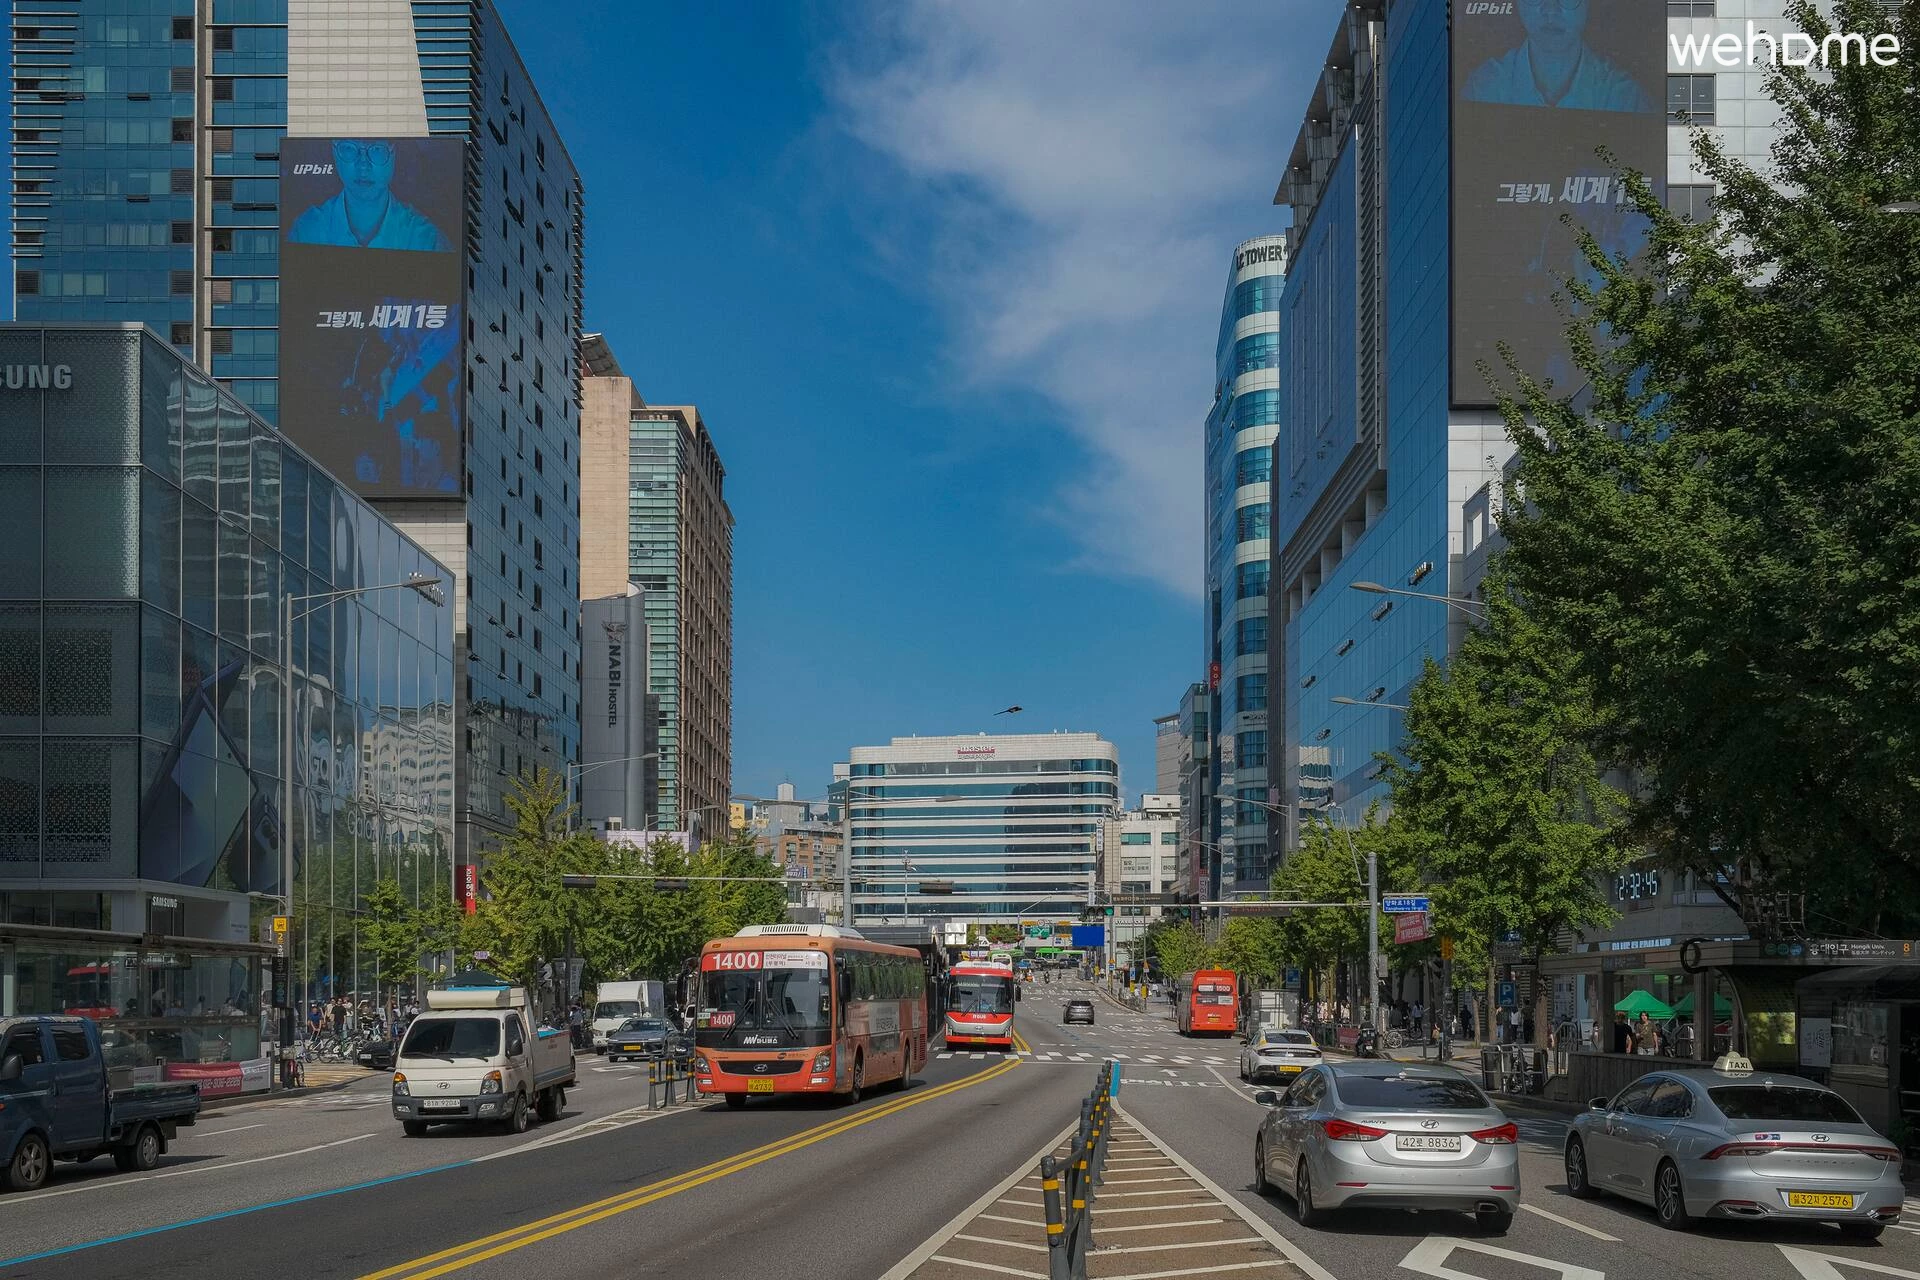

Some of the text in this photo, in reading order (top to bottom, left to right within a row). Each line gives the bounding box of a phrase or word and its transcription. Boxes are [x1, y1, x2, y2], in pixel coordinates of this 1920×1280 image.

[1465, 2, 1513, 15] UPbit
[293, 164, 334, 175] UPbit
[1496, 183, 1553, 204] 그렇게,
[1245, 245, 1283, 267] TOWER
[316, 305, 447, 329] 그렇게, 세계 1등
[0, 364, 73, 389] UNG
[609, 645, 621, 728] NABI HOSTEL
[152, 896, 178, 908] SAMSUNG
[1903, 942, 1911, 952] 8
[713, 951, 760, 970] 1400
[1503, 984, 1512, 995] P
[712, 1015, 733, 1025] 1400
[1728, 1061, 1748, 1069] TAXI
[1428, 1138, 1455, 1148] 8836
[1822, 1196, 1849, 1206] 2576
